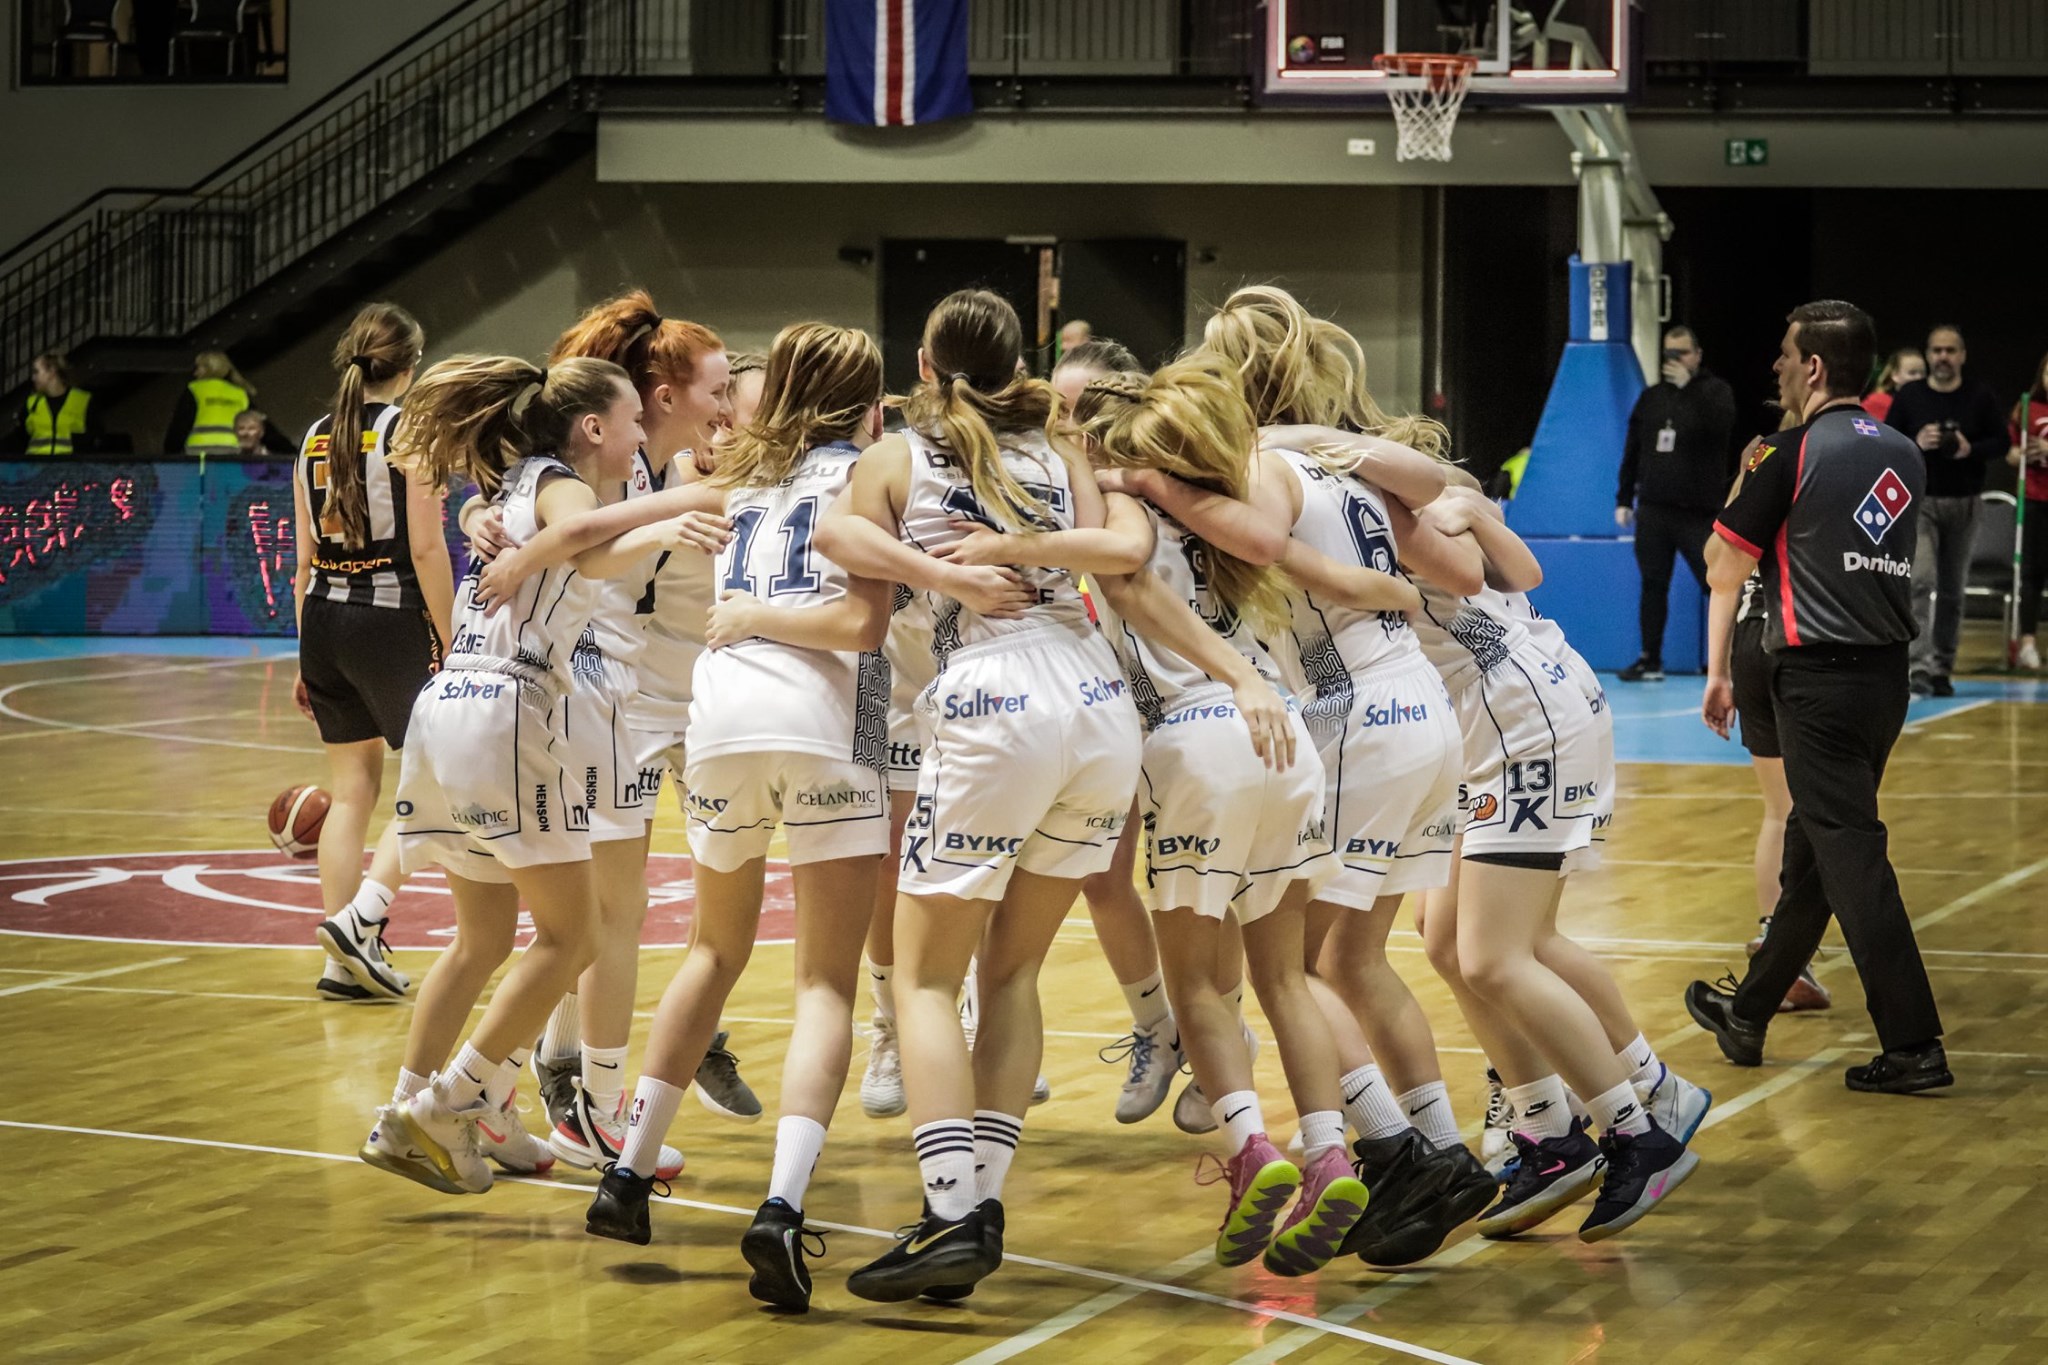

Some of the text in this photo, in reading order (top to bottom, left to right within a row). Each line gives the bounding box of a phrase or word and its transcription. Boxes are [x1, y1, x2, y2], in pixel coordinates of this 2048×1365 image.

[723, 496, 820, 598] 11
[943, 689, 1029, 720] Saltver
[586, 767, 597, 809] HENSON
[1508, 759, 1552, 794] 13
[536, 784, 550, 832] HENSON
